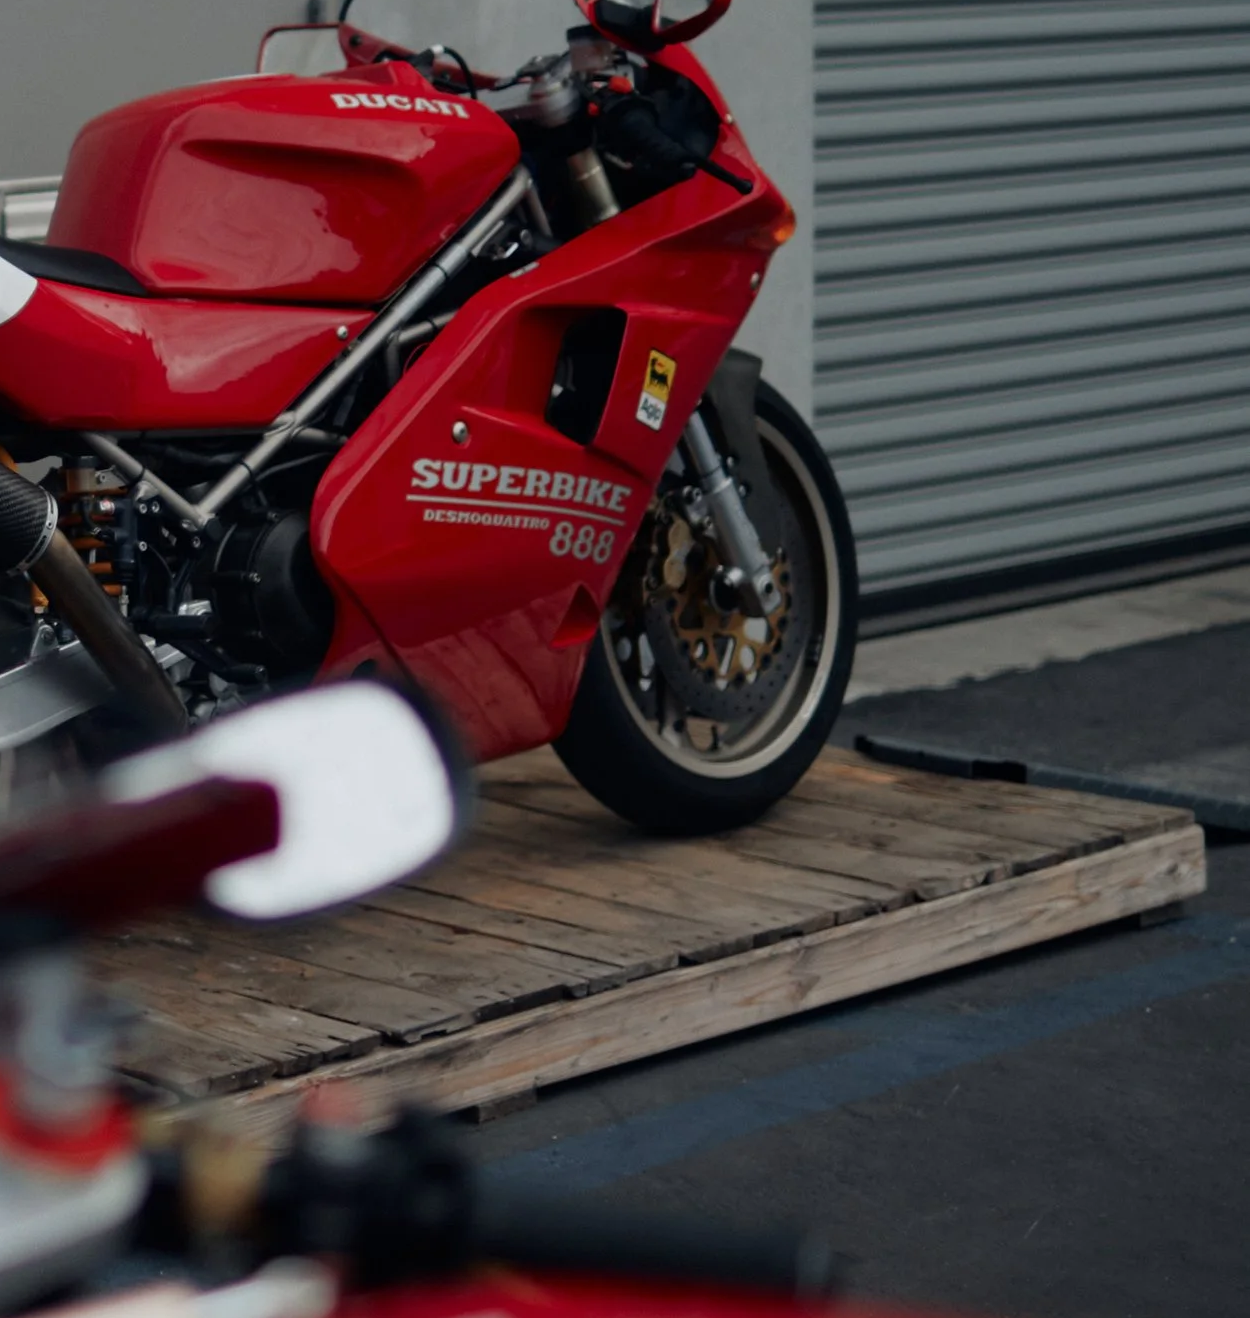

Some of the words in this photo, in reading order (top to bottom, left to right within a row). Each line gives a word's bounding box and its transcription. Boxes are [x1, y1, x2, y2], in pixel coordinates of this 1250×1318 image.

[330, 93, 470, 119] DUCATI
[411, 458, 632, 513] SUPERBIKE
[423, 508, 550, 530] DESMOQUATTRO
[549, 520, 615, 564] 888
